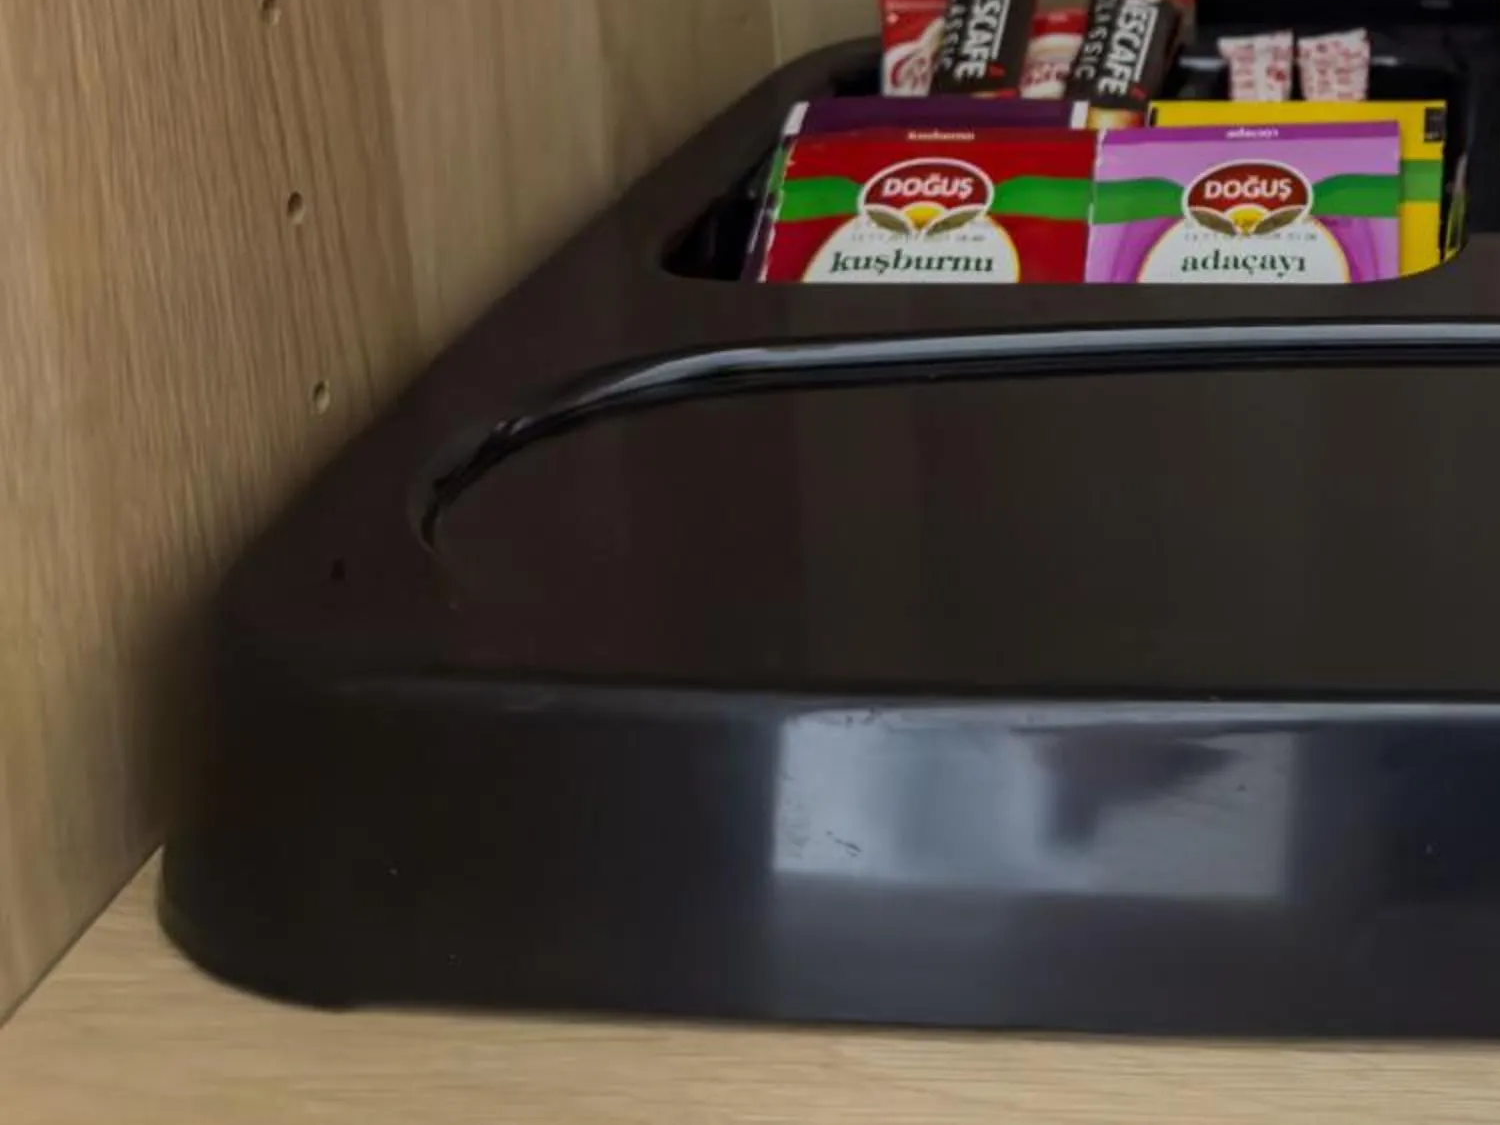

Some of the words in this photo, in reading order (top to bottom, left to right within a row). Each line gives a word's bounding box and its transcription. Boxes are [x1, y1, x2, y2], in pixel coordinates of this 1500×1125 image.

[882, 173, 975, 200] DOĞUŞ
[1204, 177, 1293, 202] DOĞUŞ
[829, 249, 994, 274] kuşburnu
[1180, 249, 1307, 277] adaçayı
